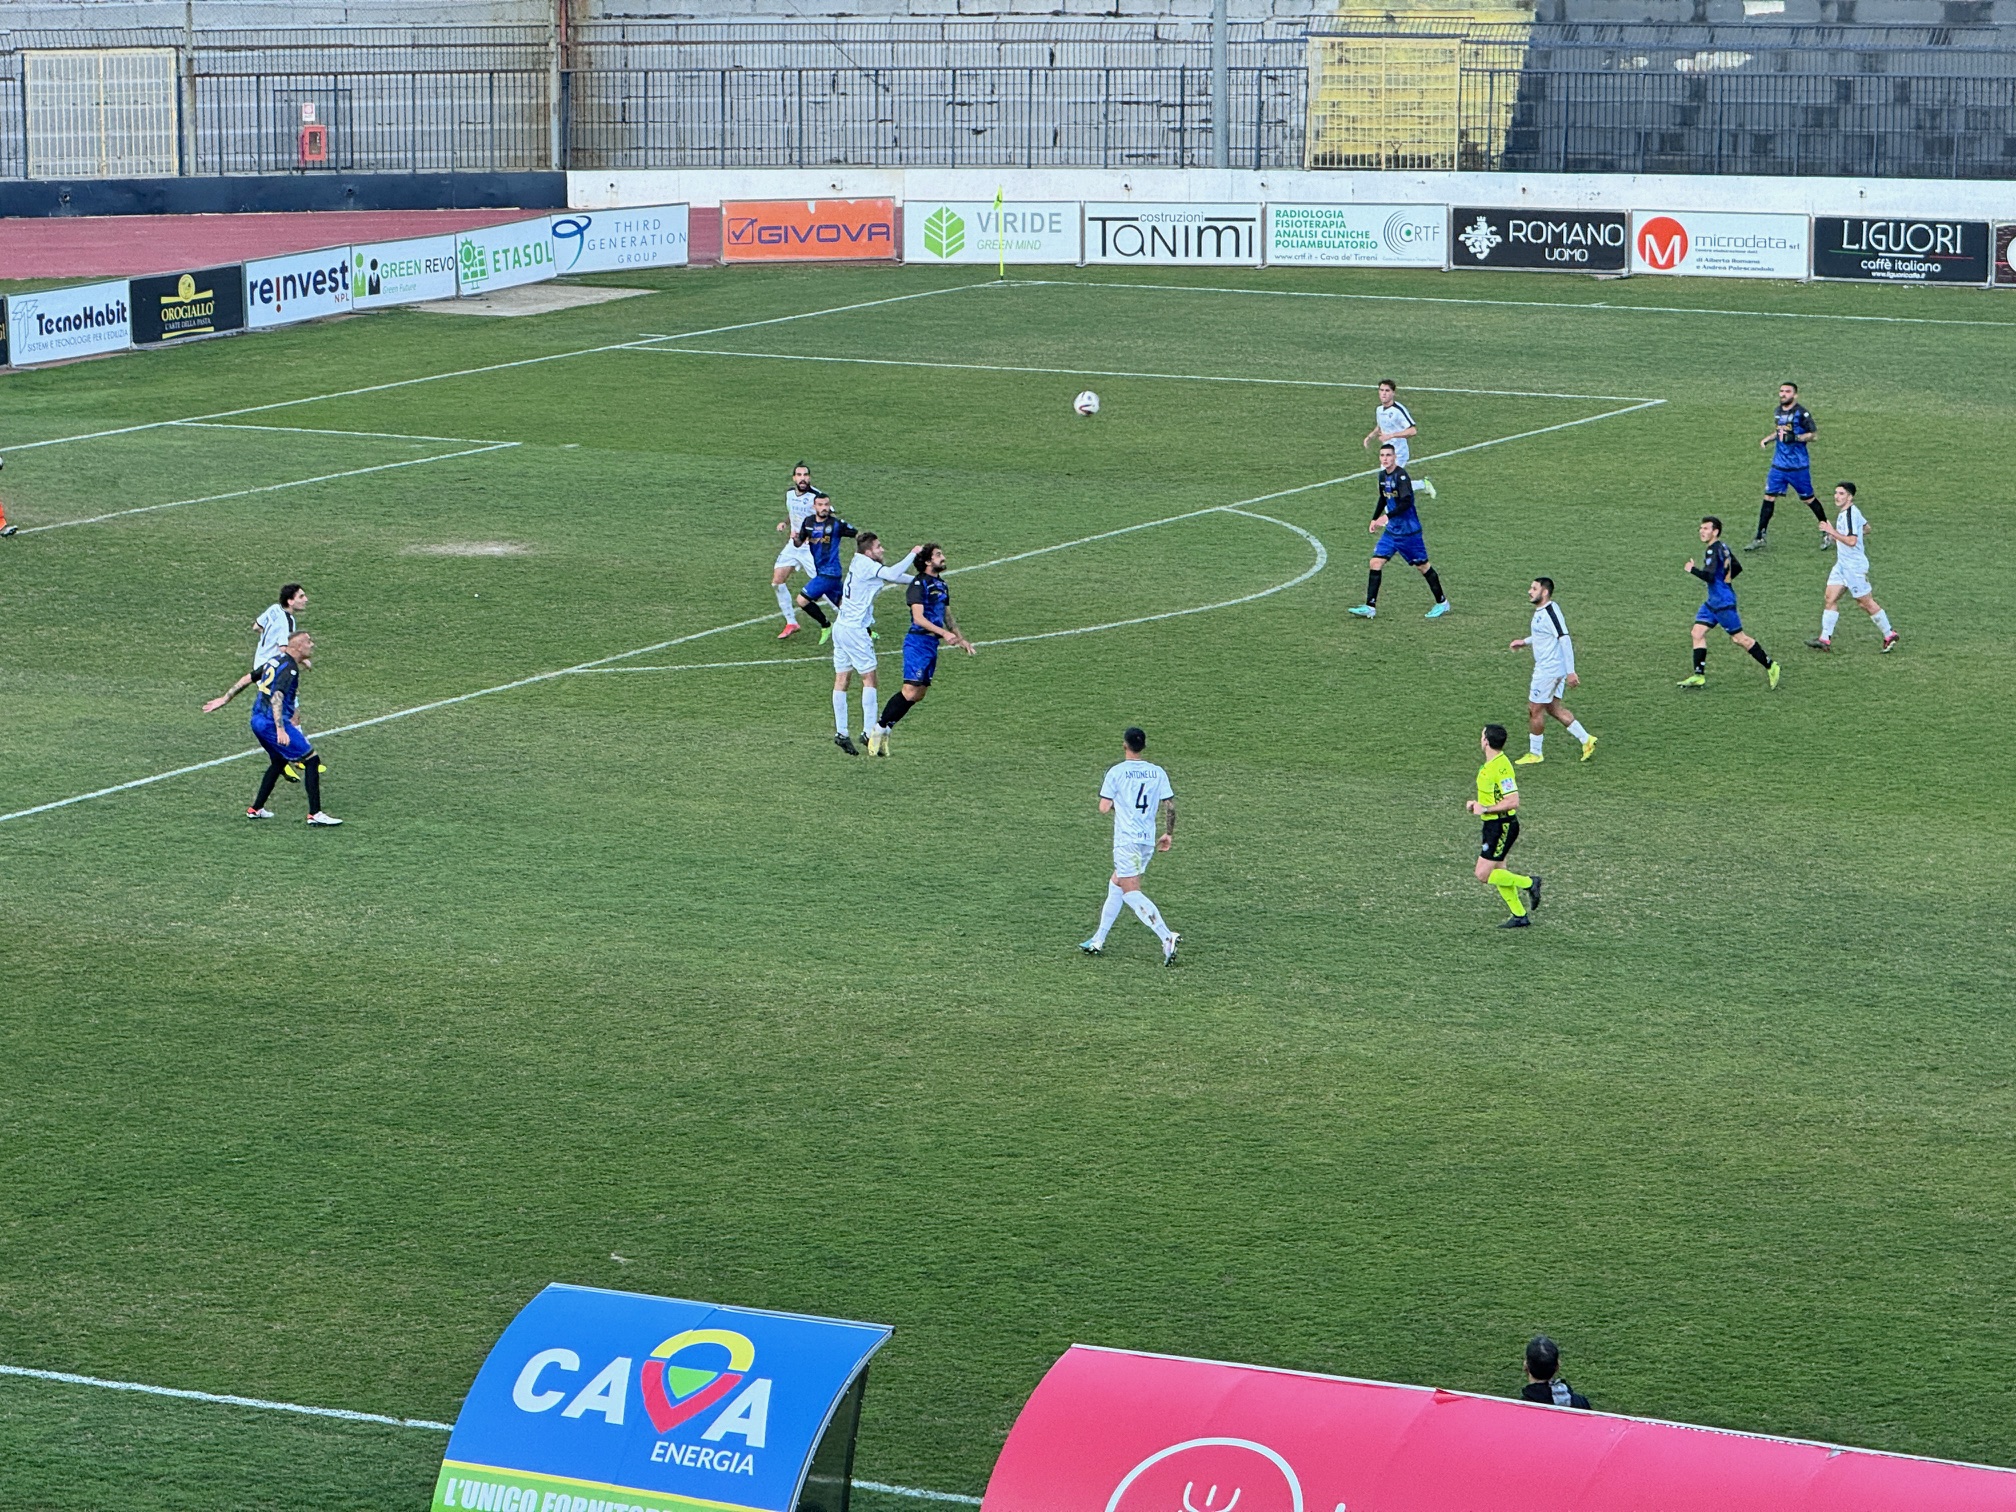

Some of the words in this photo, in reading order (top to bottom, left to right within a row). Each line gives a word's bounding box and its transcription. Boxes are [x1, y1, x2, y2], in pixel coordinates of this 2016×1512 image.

[976, 212, 1062, 233] VIRIDE
[1139, 211, 1204, 223] costruzioni
[1275, 209, 1344, 219] RADIOLOGIA
[1275, 219, 1347, 229] FISIOTERAPIA
[615, 218, 661, 233] THIRD
[757, 222, 890, 245] GIVOVA
[1275, 229, 1318, 239] ANALISI
[1321, 230, 1370, 239] CLINICHE
[1398, 222, 1440, 243] CRTF
[1509, 219, 1625, 247] ROMANO
[587, 231, 687, 251] GENERATION
[977, 239, 1013, 250] GREEN
[1015, 239, 1042, 250] MIND
[1275, 239, 1378, 250] POLIAMBULATORIO
[1695, 233, 1787, 249] microdata
[1841, 219, 1962, 254] LIGUORI
[492, 240, 553, 273] ETASOL
[617, 252, 658, 264] GROUP
[1274, 253, 1313, 261] www.crtf.it
[1320, 253, 1339, 261] Cava
[1353, 253, 1378, 261] Tirreni
[1545, 247, 1589, 262] UOMO
[1645, 233, 1682, 266] M
[380, 259, 422, 279] GREEN
[425, 256, 455, 274] REVO
[1860, 258, 1892, 270] caffè
[1894, 259, 1942, 273] italiano
[334, 293, 350, 304] NPL
[382, 285, 398, 295] Green
[399, 283, 417, 292] Future
[36, 299, 127, 336] TecnoHabit
[161, 302, 214, 322] OROGIALLO
[27, 340, 49, 352] SISTEMI
[50, 341, 54, 349] E
[55, 334, 92, 348] TECNOLOGIE
[92, 331, 102, 341] PER
[1135, 782, 1149, 814] 4
[650, 1440, 754, 1476] ENERGIA
[443, 1477, 539, 1512] L'UNICO
